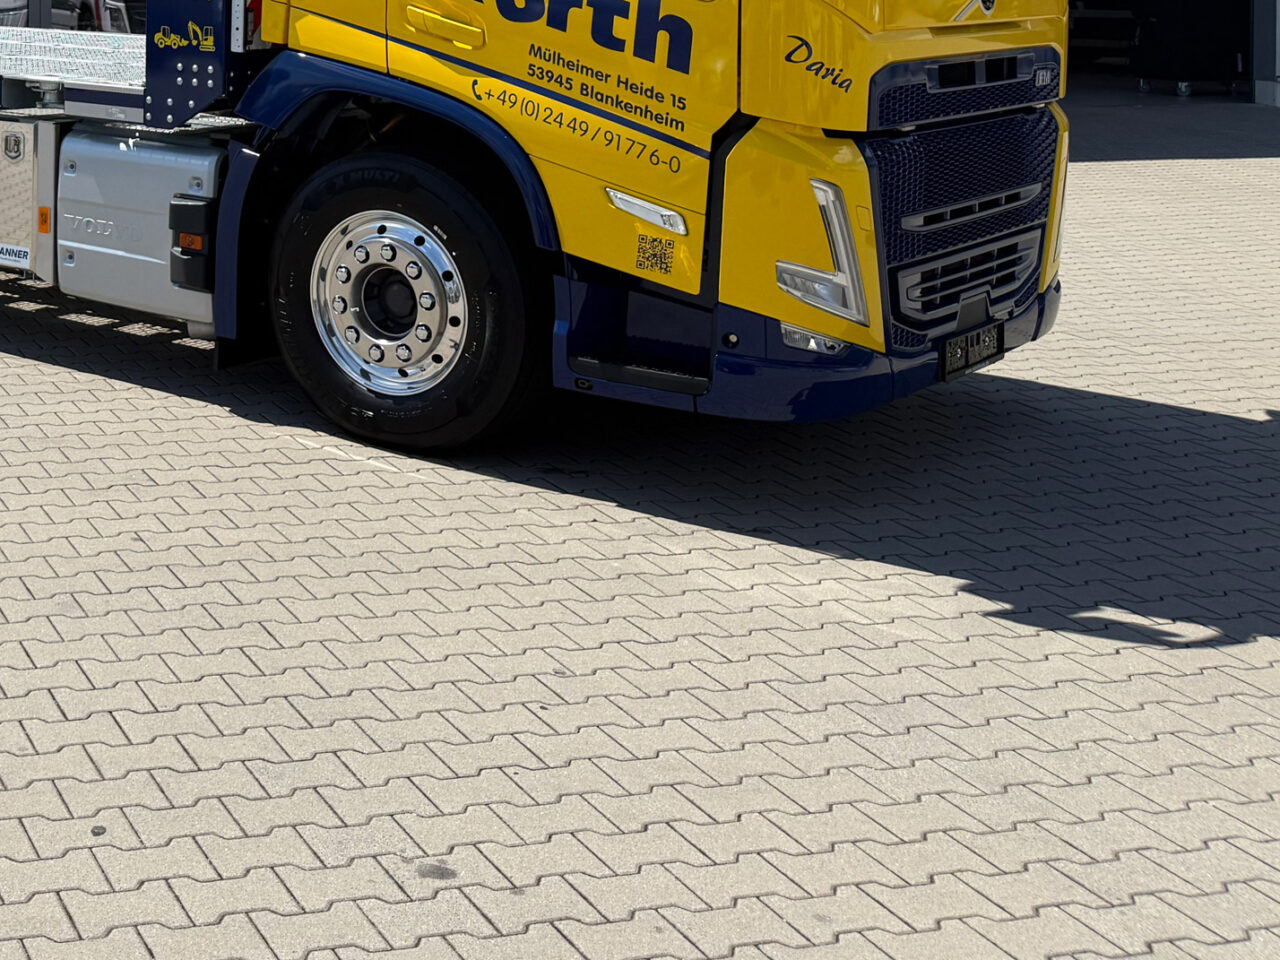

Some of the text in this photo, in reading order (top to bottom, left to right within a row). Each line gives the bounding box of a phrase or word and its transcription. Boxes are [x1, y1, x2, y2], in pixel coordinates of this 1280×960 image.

[527, 63, 685, 132] 53945 Blankenheim
[529, 43, 687, 111] Mülheimer Heide 15
[784, 35, 853, 93] Daria
